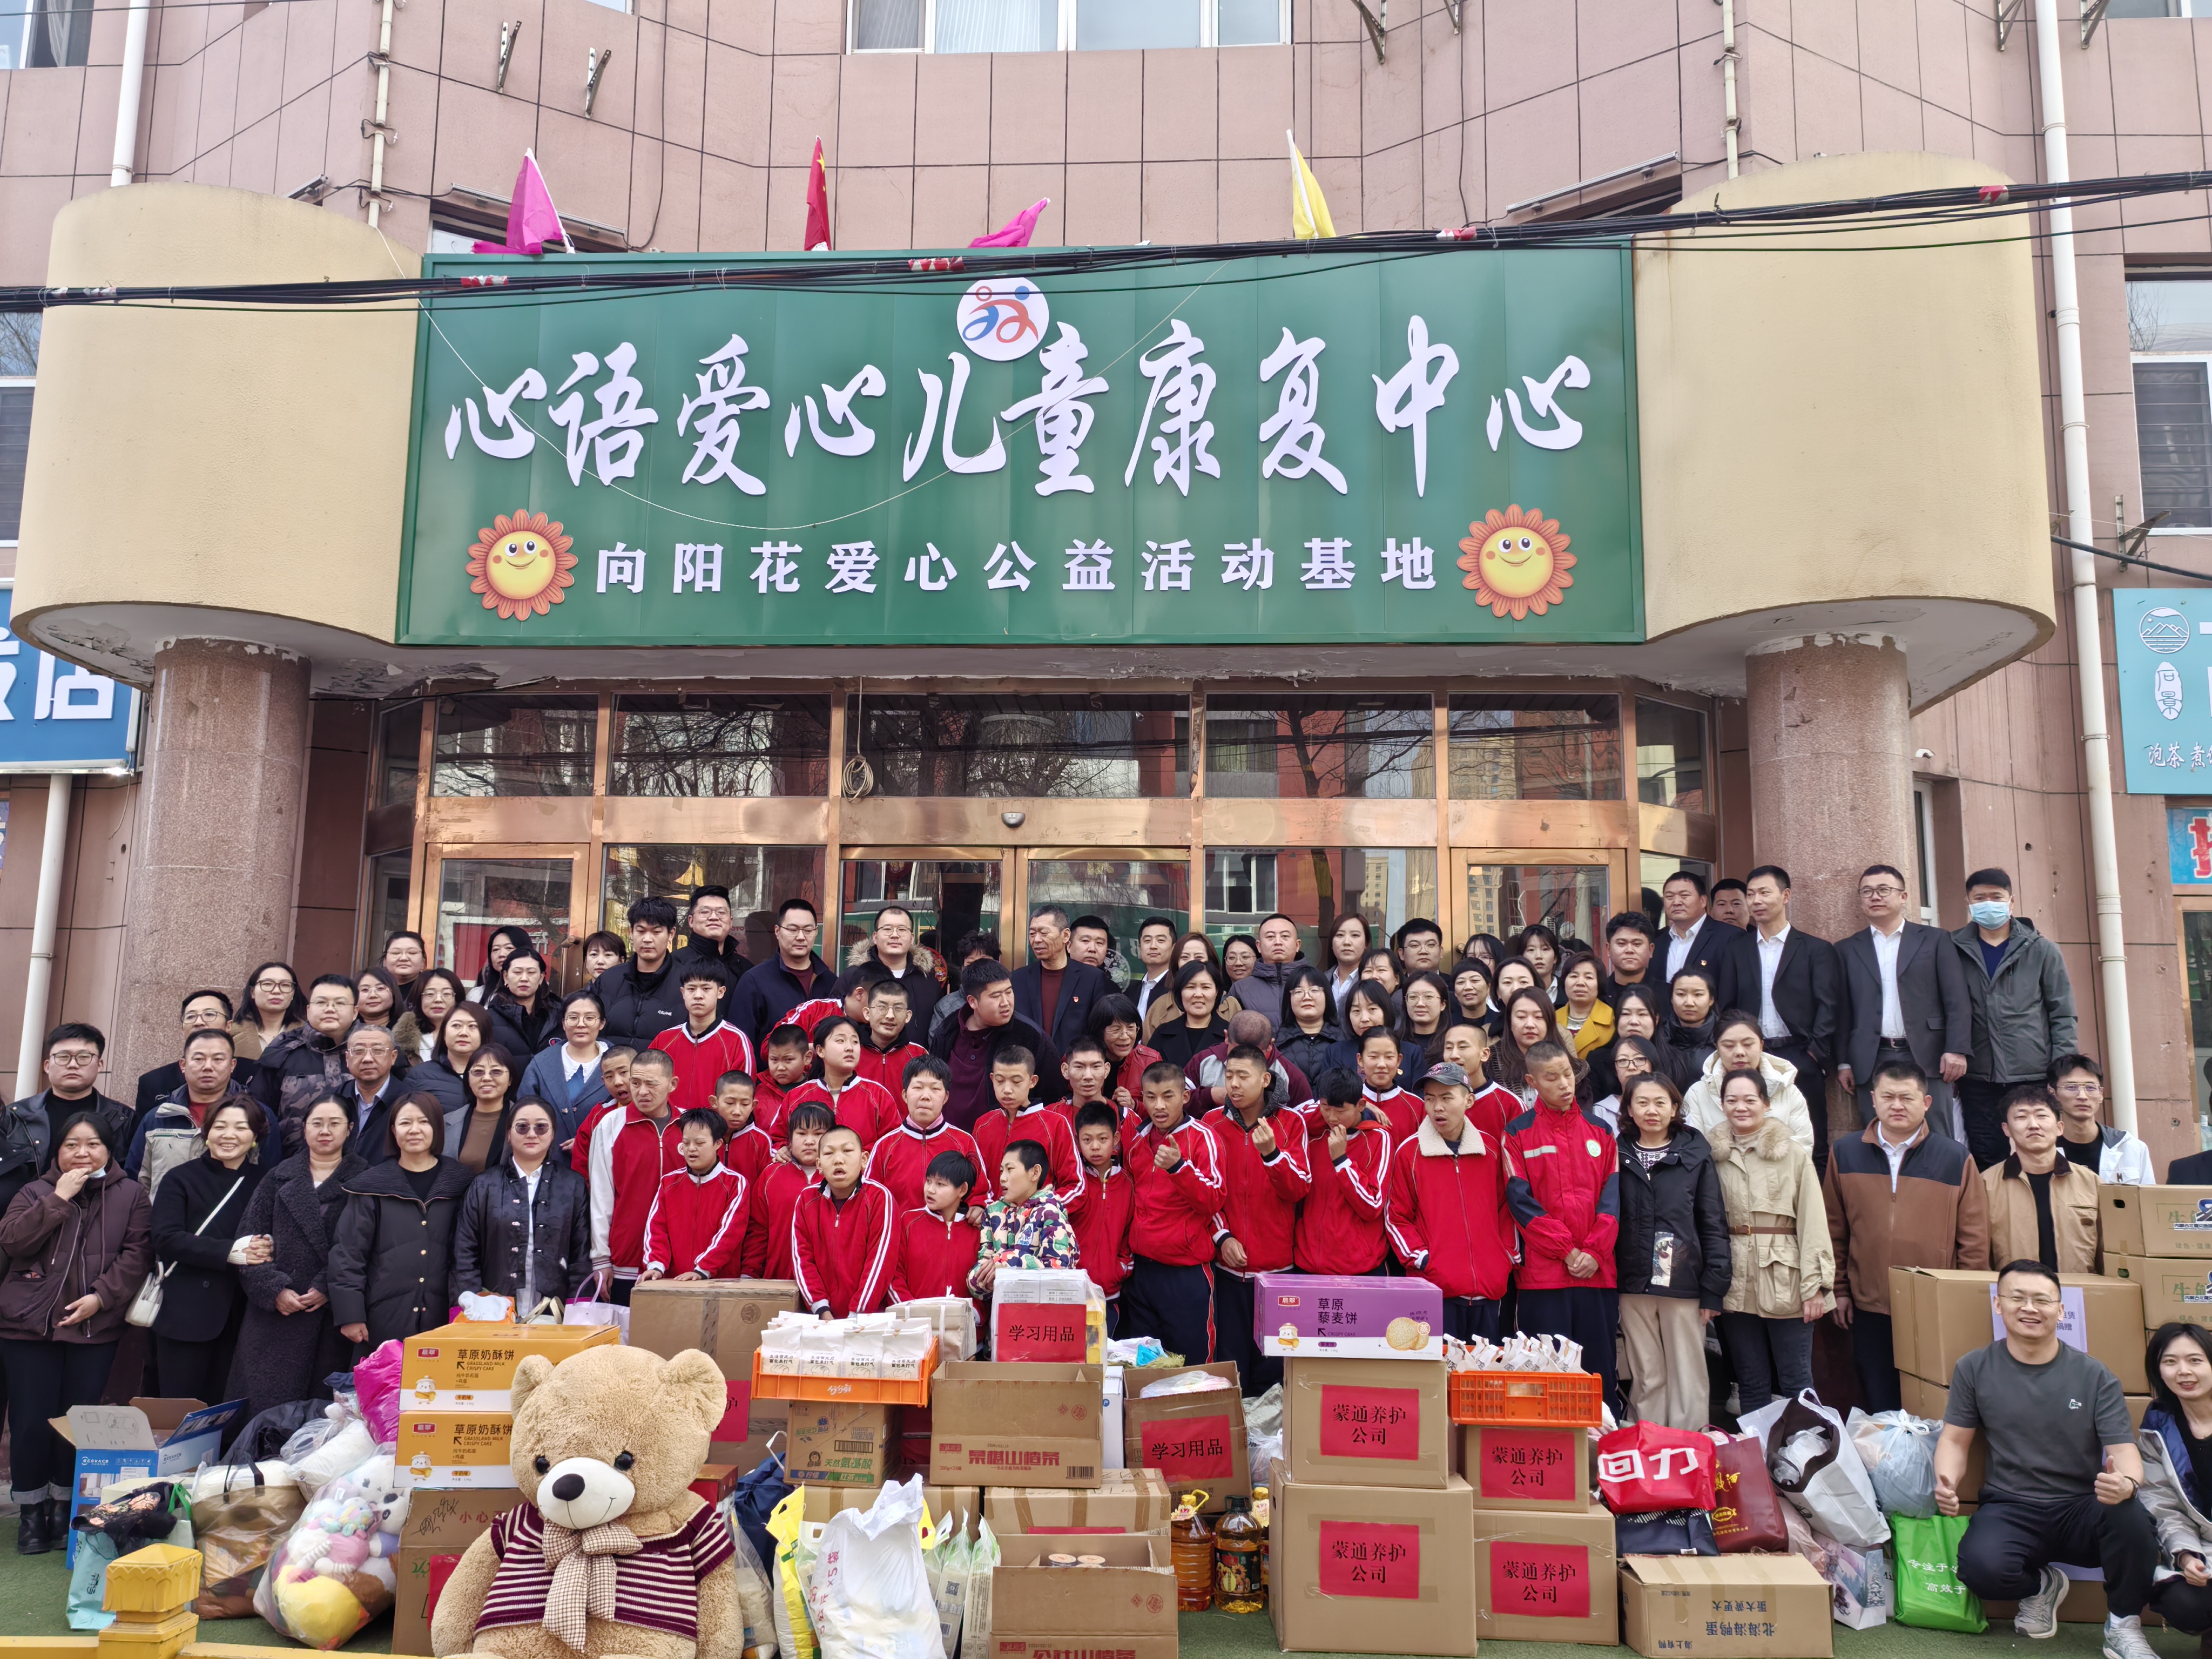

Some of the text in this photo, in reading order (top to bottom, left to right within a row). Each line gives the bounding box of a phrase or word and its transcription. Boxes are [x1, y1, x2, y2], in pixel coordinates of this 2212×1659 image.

[445, 314, 1591, 498] 心语爱心儿童康复中心
[595, 536, 1437, 594] 向阳花爱心公益活动基地
[2149, 741, 2184, 768] 泡茶
[1318, 1298, 1344, 1311] 草原
[1318, 1312, 1358, 1325] 藜麦饼
[1008, 1325, 1075, 1342] 学习用品
[457, 1349, 515, 1361] 草原奶酥饼
[1333, 1404, 1406, 1425] 蒙通养护
[455, 1424, 512, 1435] 草原奶酥饼
[1351, 1427, 1386, 1445] 公司
[1151, 1438, 1223, 1460] 学习用品
[1492, 1447, 1563, 1465] 蒙通养护
[824, 1456, 873, 1469] 天然氨基酸
[1597, 1447, 1699, 1483] 回力
[1510, 1469, 1545, 1487] 公司
[460, 1510, 504, 1523] 小心
[1331, 1541, 1407, 1561] 蒙通养护
[1351, 1566, 1386, 1584] 公司
[1503, 1561, 1576, 1581] 蒙通养护
[1522, 1585, 1557, 1603] 公司
[1925, 1583, 1966, 1595] 高效于
[1712, 1600, 1768, 1612] 蛋大黄更大
[1705, 1621, 1776, 1637] 北海海鸭蛋
[1658, 1640, 1693, 1650] 海上有鸭
